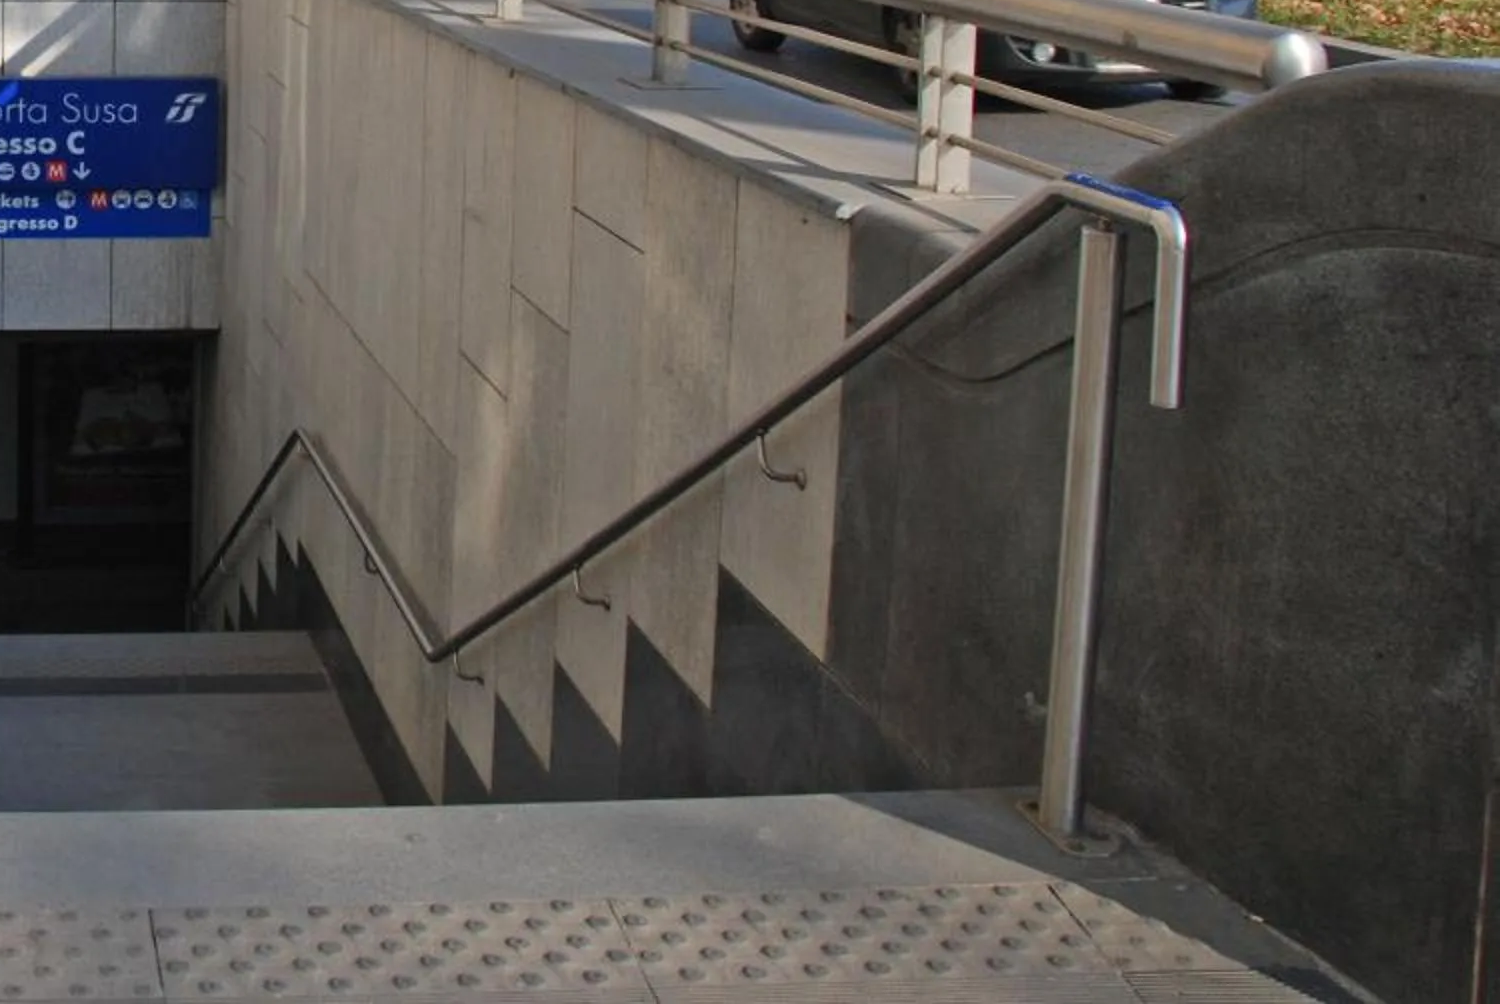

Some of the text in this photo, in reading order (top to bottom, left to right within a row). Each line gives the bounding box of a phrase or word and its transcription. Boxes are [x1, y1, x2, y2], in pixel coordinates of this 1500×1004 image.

[61, 93, 138, 124] Susa
[66, 130, 85, 155] C
[49, 165, 64, 177] M
[91, 192, 108, 208] M
[64, 215, 78, 230] D
